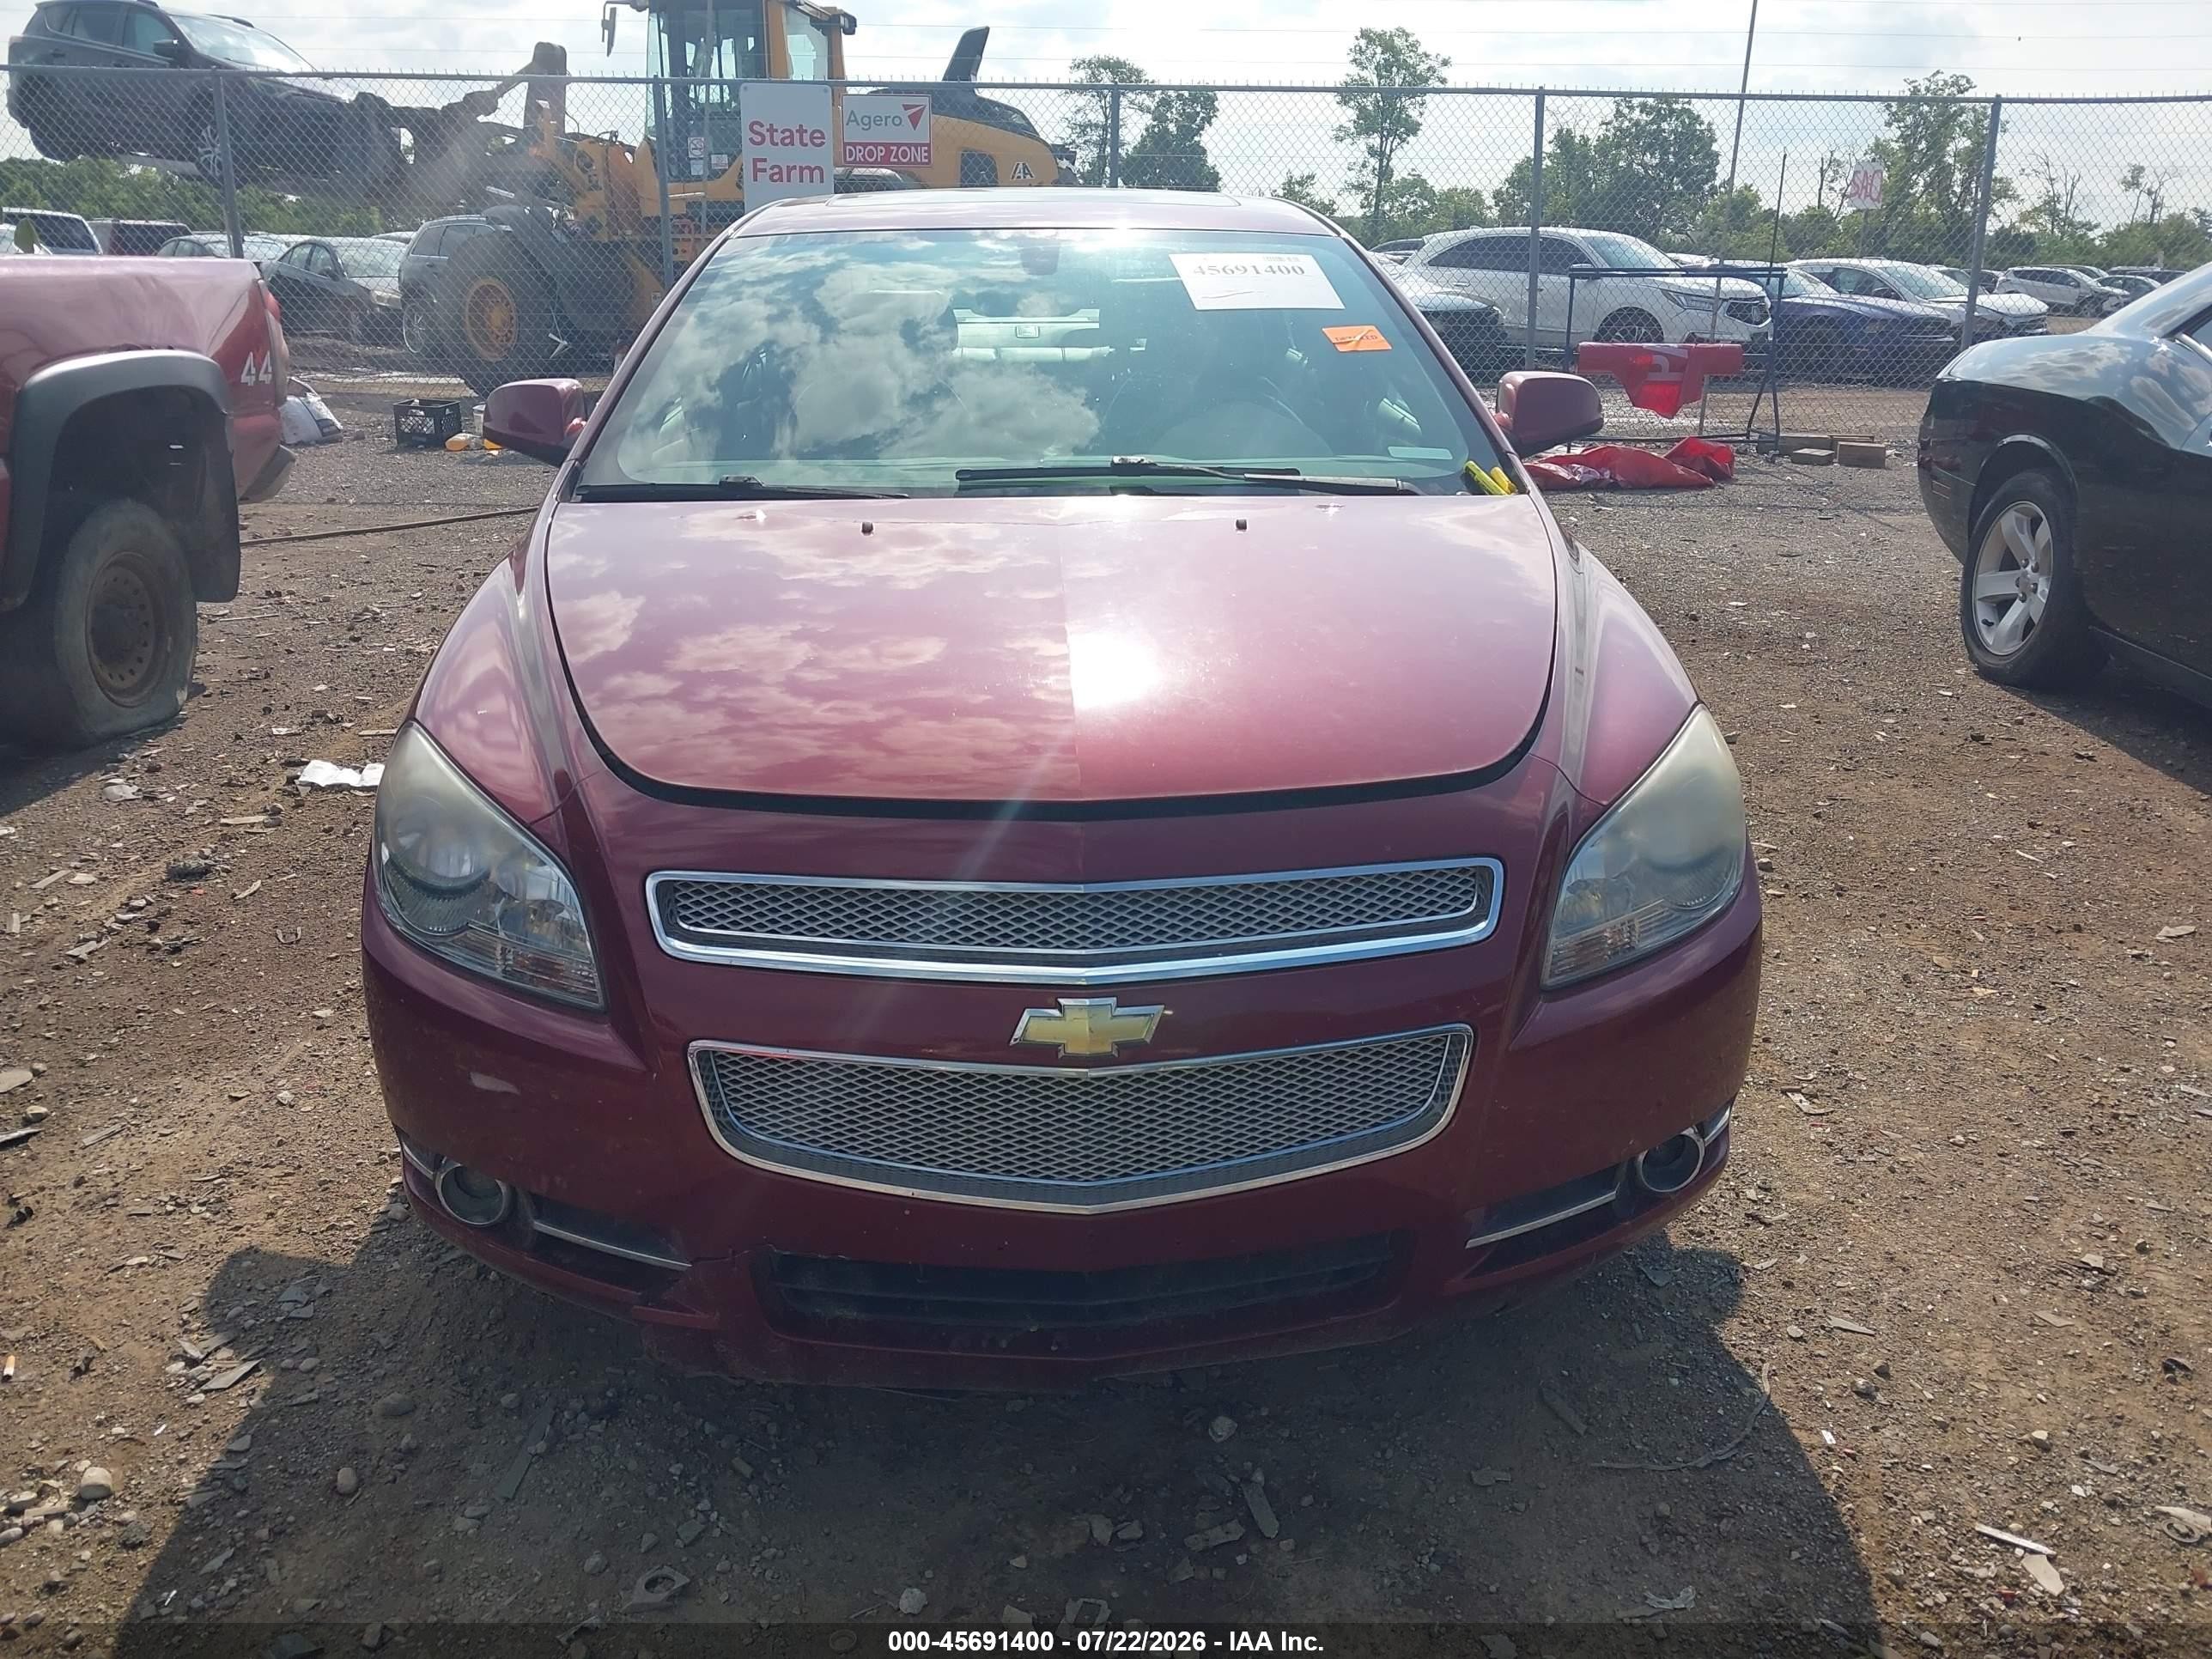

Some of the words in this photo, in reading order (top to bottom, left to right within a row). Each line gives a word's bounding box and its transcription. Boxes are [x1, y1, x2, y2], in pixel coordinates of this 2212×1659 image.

[846, 109, 902, 131] Agero
[748, 120, 826, 148] State
[846, 145, 885, 162] DROP
[890, 146, 929, 163] ZONE
[752, 157, 824, 184] Farm
[1193, 264, 1305, 276] 45691400
